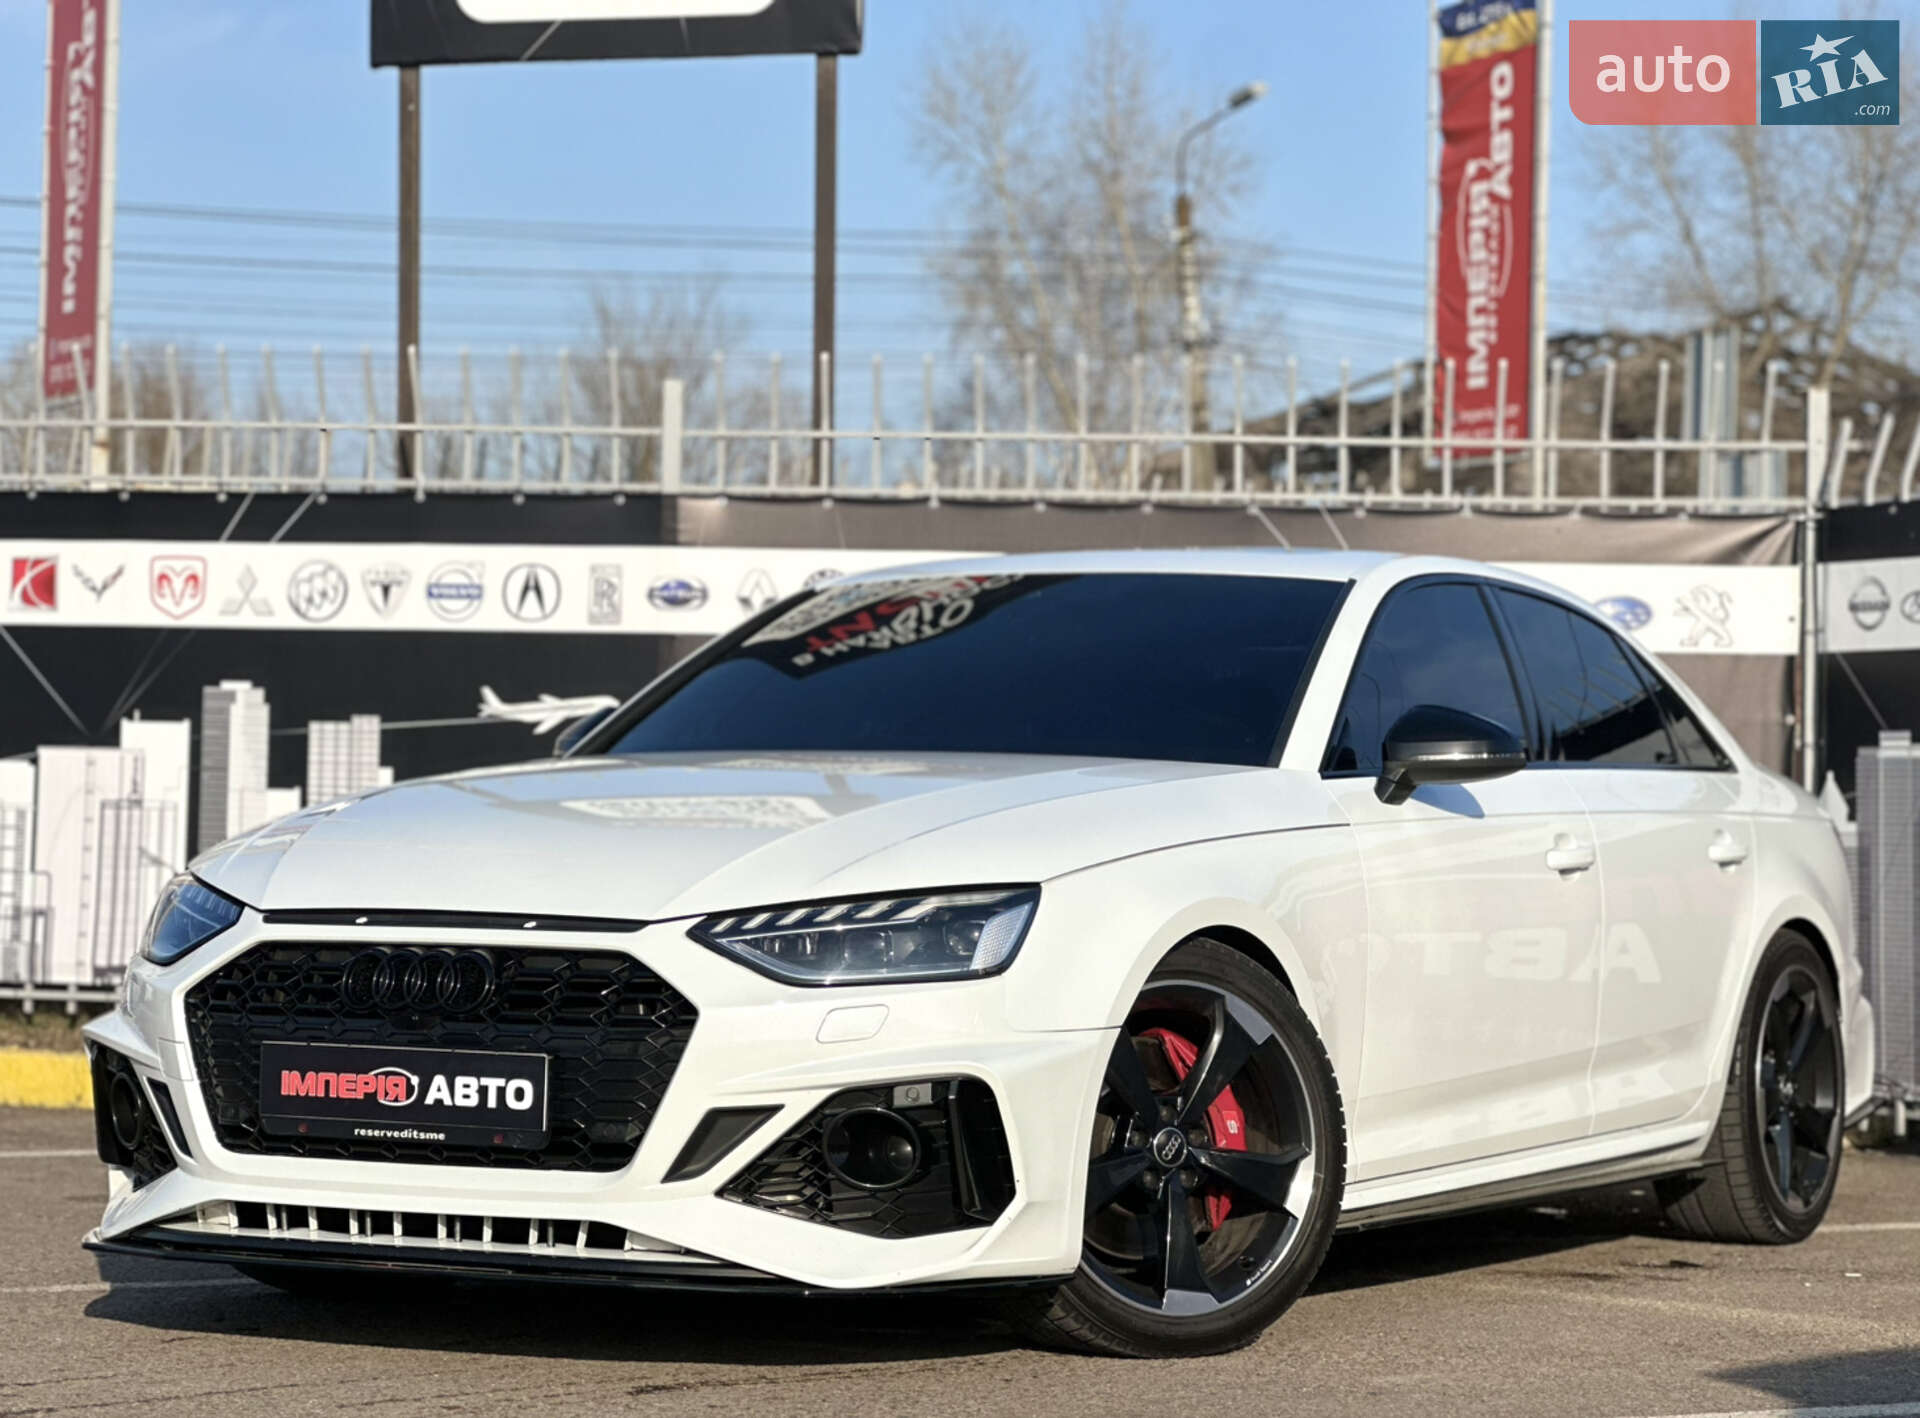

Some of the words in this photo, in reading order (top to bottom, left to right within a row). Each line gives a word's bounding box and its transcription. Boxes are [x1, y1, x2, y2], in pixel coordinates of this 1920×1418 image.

[1490, 60, 1515, 200] АВТО
[280, 1070, 407, 1102] ІМПЕРІЯ
[424, 1074, 534, 1110] АВТО
[353, 1128, 446, 1141] reserveditsme
